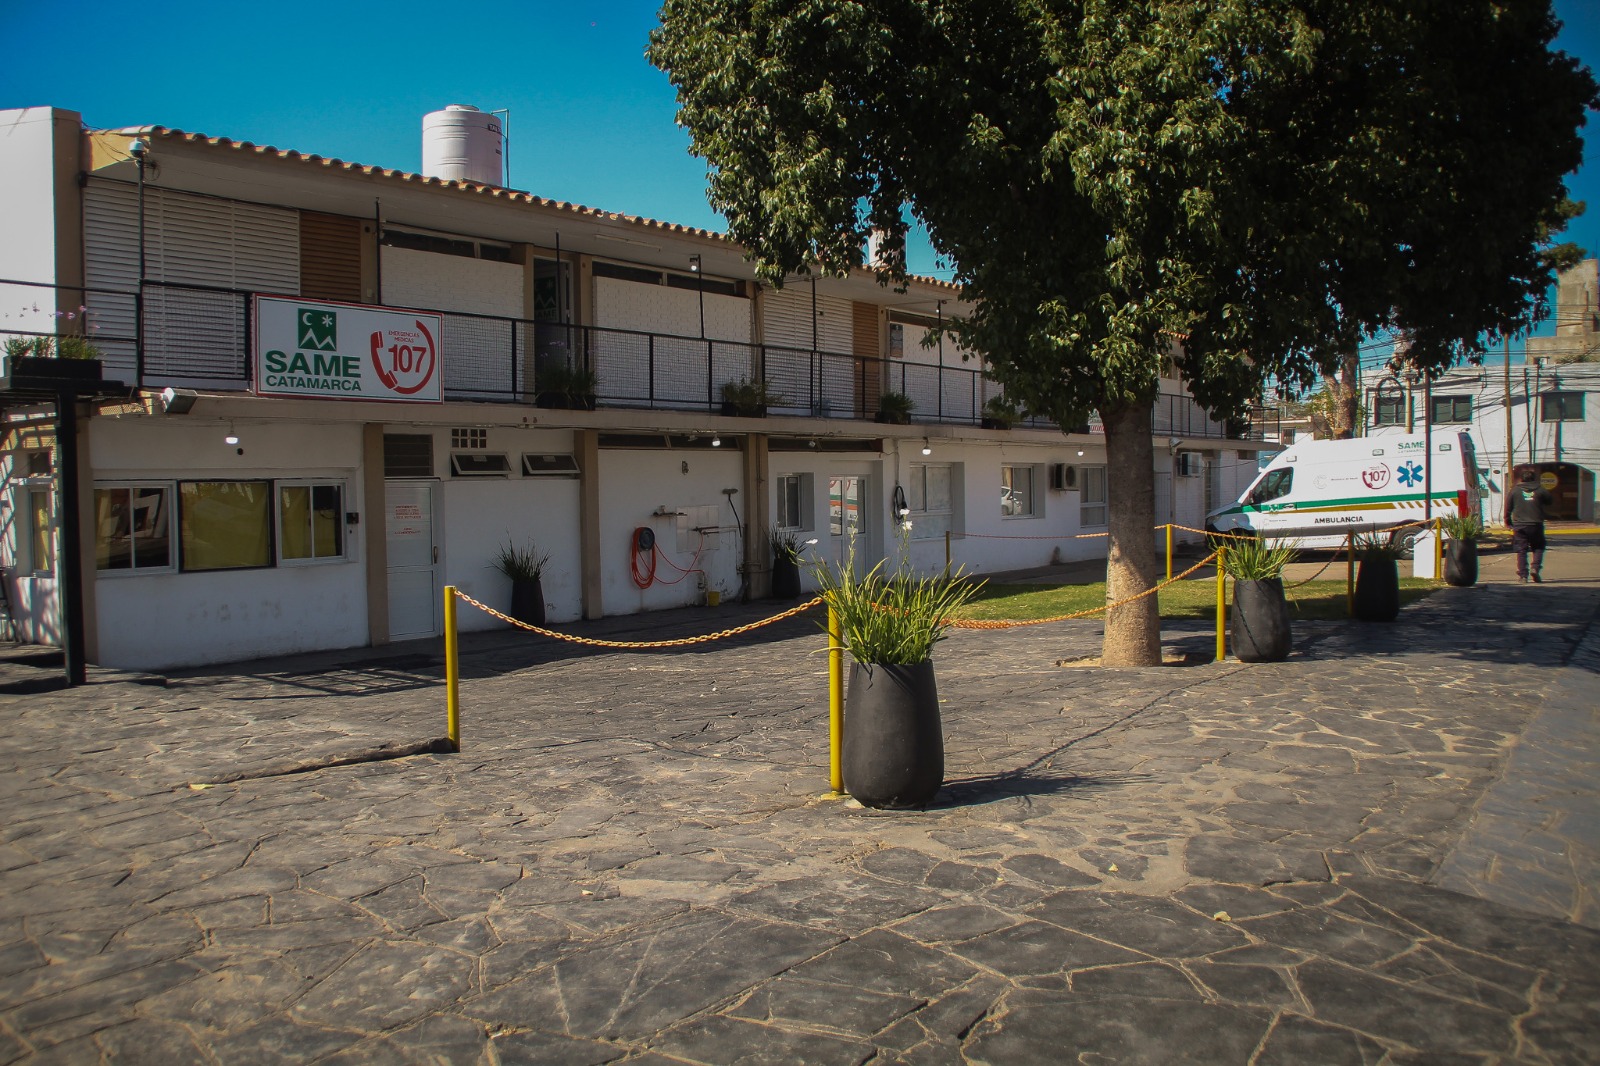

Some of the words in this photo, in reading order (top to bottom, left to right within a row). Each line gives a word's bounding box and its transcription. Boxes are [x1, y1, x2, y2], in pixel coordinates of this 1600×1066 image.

[265, 350, 362, 379] SAME
[388, 344, 427, 373] 107
[265, 375, 362, 392] CATAMARCA
[1397, 440, 1425, 450] SAME
[1368, 470, 1387, 482] 107
[1314, 516, 1364, 524] AMBULANCIA
